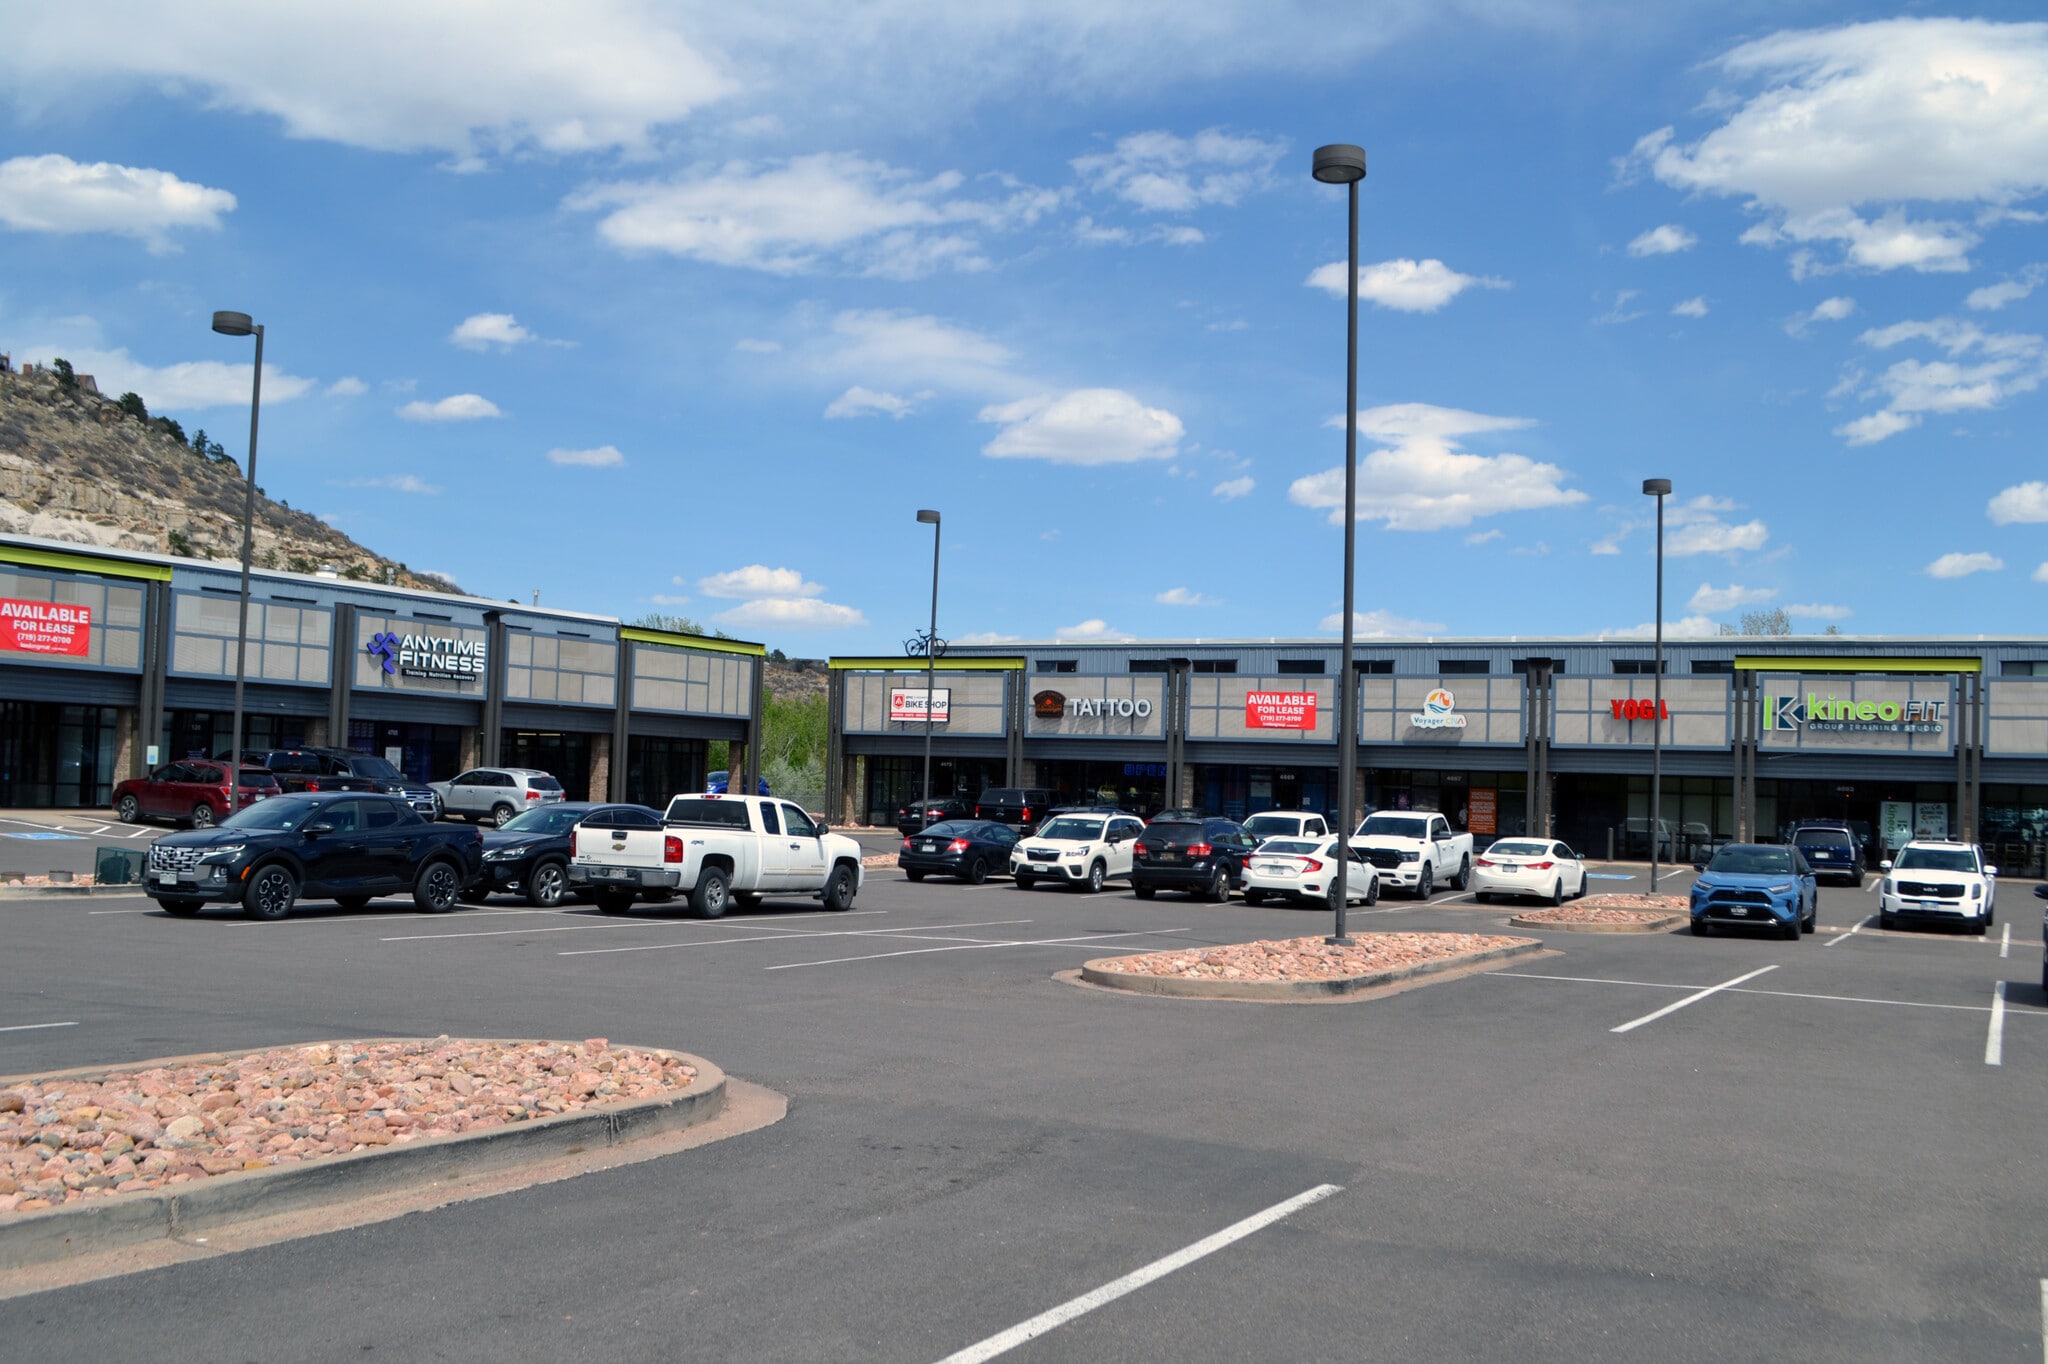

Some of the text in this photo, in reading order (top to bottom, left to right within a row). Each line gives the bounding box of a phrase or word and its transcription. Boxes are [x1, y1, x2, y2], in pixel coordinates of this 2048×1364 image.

[1, 603, 89, 624] AVAILABLE
[13, 620, 75, 635] FOR LEASE
[401, 634, 486, 657] ANYTIME
[399, 650, 485, 673] FITNESS
[905, 701, 923, 709] BIKE
[1248, 694, 1315, 706] AVAILABLE
[1070, 699, 1152, 717] TATTOO
[1276, 706, 1305, 715] LEASE
[1414, 716, 1443, 726] Voyager
[1809, 722, 1943, 733] GROUP TRAINING STUDIO
